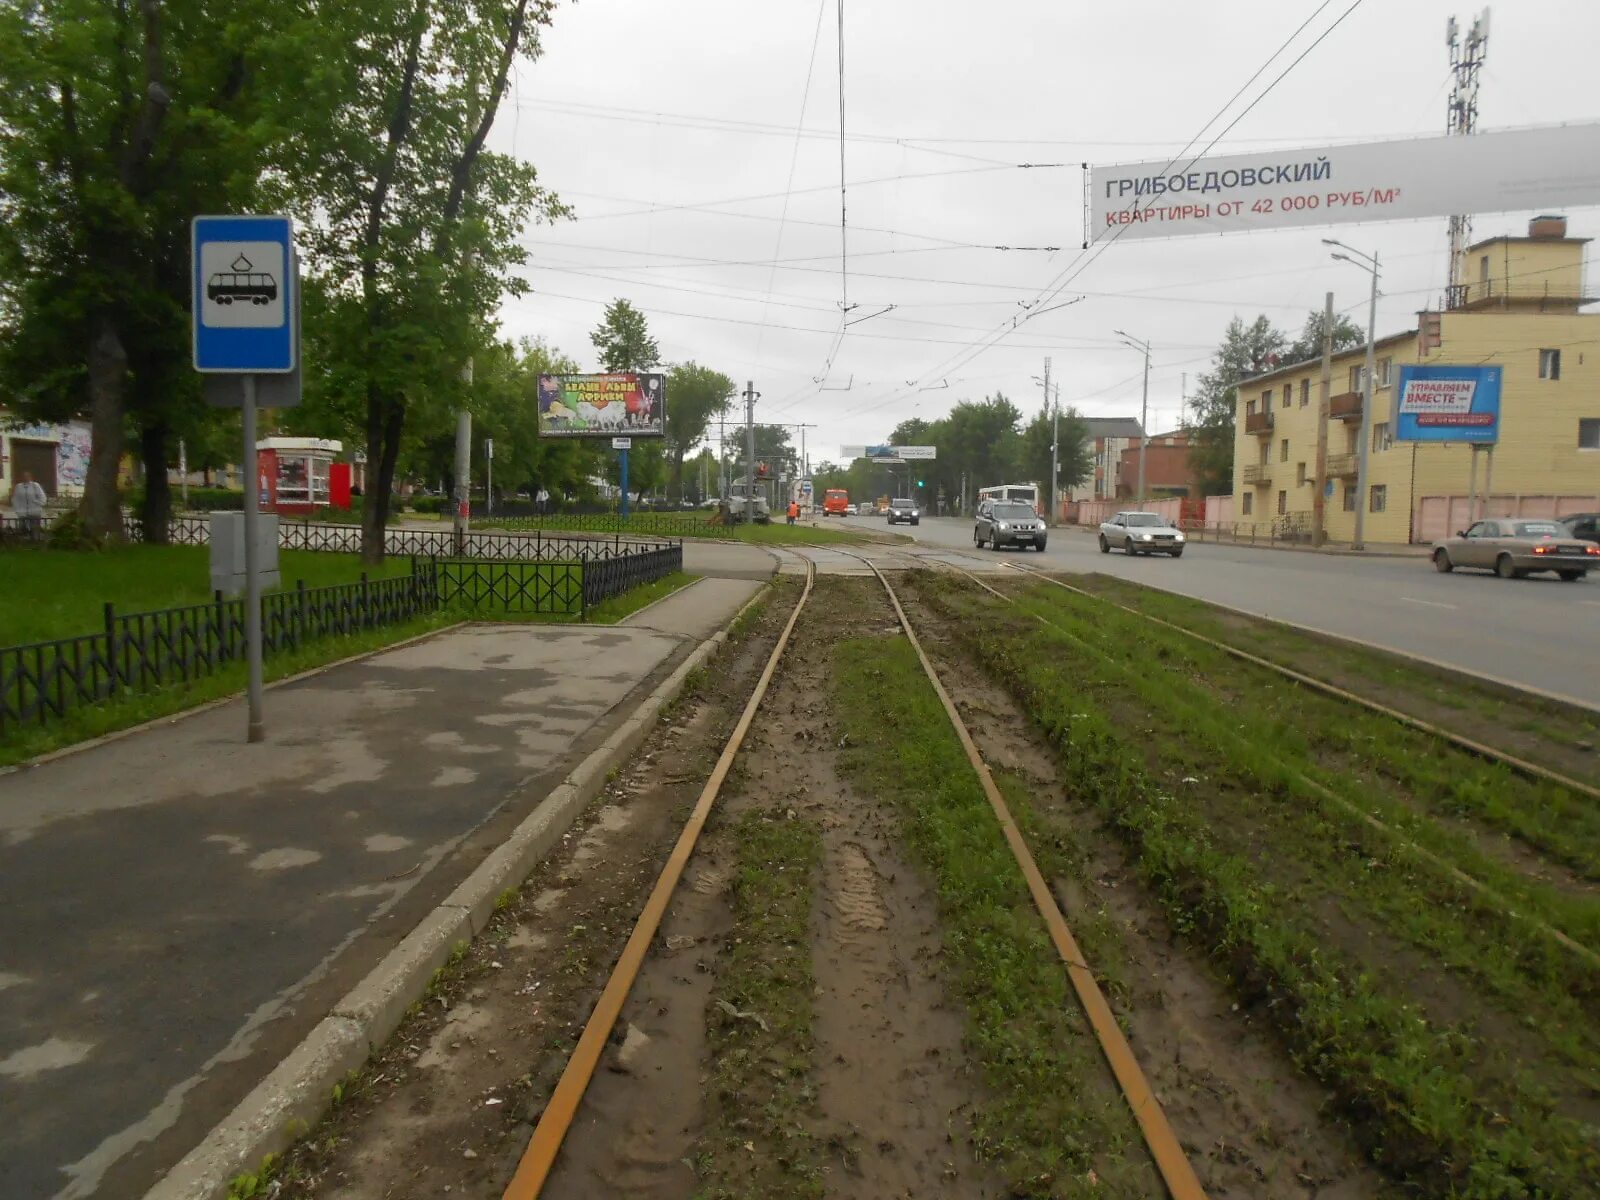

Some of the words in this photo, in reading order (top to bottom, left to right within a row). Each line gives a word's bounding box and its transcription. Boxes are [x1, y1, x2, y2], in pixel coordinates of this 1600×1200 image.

[1105, 156, 1332, 198] ГРИБОЕДОВСКИЙ
[1105, 204, 1211, 226] КВАРТИРЫ
[1216, 201, 1245, 217] ОТ
[1251, 198, 1274, 214] 42
[1280, 194, 1320, 211] 000
